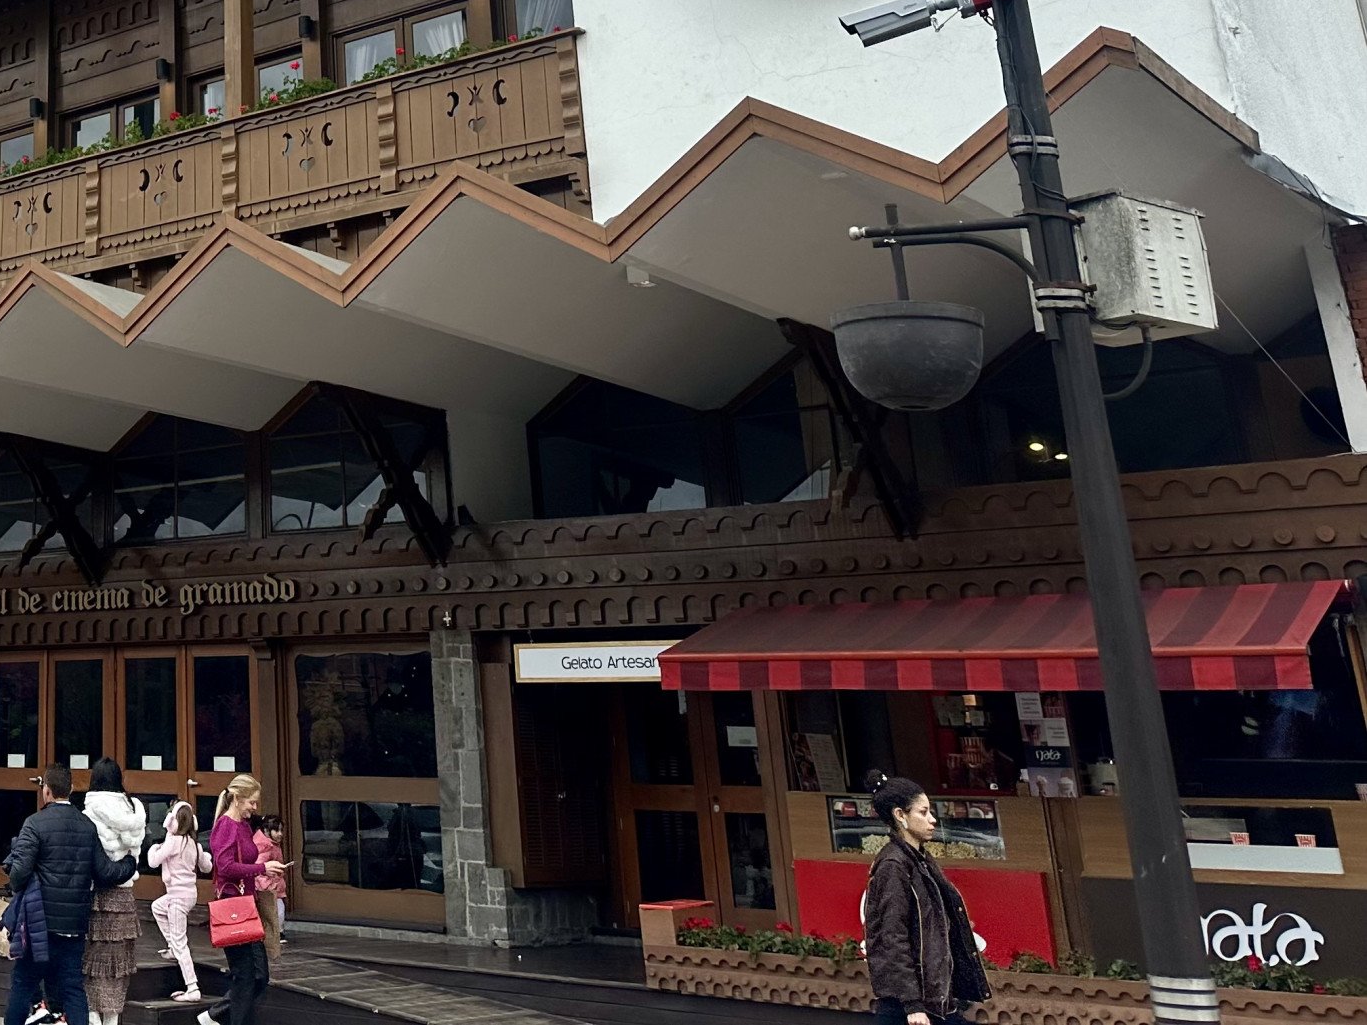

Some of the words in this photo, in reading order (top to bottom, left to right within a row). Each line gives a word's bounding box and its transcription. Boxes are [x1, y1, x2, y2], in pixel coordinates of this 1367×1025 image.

[17, 587, 43, 614] de
[51, 588, 131, 611] cinema
[141, 578, 169, 608] de
[179, 573, 296, 615] gramado
[561, 656, 603, 670] Gelato
[1036, 749, 1062, 761] nata
